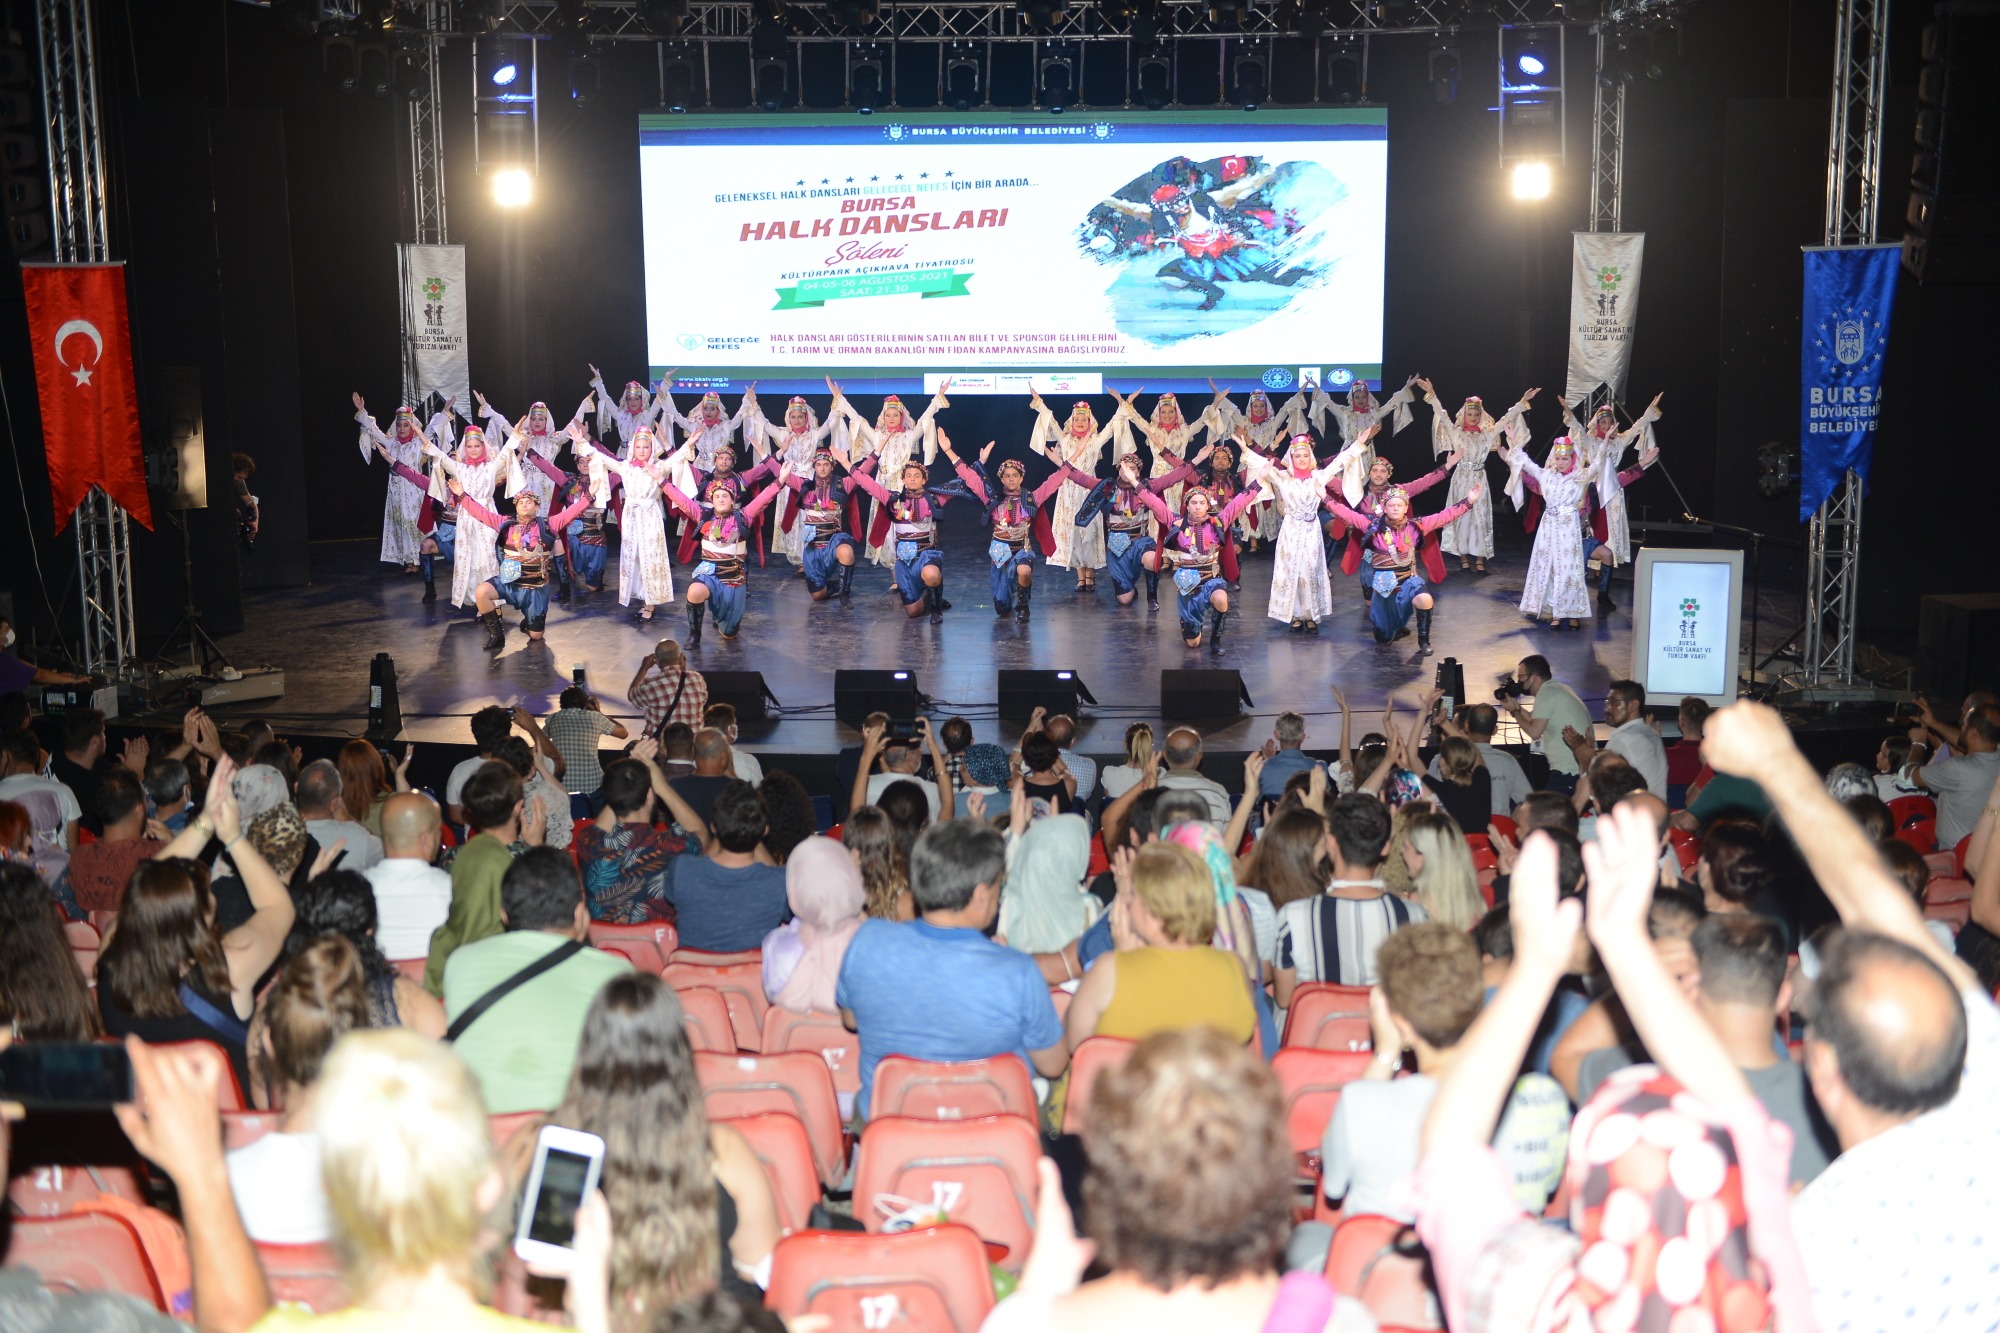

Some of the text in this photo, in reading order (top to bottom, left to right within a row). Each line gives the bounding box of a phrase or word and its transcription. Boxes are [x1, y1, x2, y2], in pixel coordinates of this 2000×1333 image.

[912, 126, 1086, 136] BURSA BÜYÜKŞEHİR BELEDİYESİ
[715, 178, 1039, 203] GELENEKSEL HALK DANSLARI GELECEĞE NEFES İÇİN BİR ARADA...
[840, 196, 916, 214] BURSA
[739, 208, 1009, 242] HALK DANSLARI
[824, 240, 908, 268] Şöleni
[781, 258, 974, 280] KÜLTÜRPARK AÇIKHAVA TİYATROSU
[803, 272, 948, 290] 04-05-06 AĞUSTOS 2021
[840, 284, 908, 296] SAAT: 21.30
[1578, 325, 1602, 333] KÜLTÜR
[1596, 318, 1618, 326] BURSA
[413, 342, 437, 350] URİZM
[770, 333, 1117, 342] HALK DANSLARI GÖSTERİLERİNİN SATILAN BİLET VE SPONSOR GELİRLERİNİ
[771, 346, 788, 354] T.C.
[792, 346, 820, 354] TARIM
[824, 346, 835, 354] VE
[838, 346, 872, 354] ORMAN
[874, 345, 944, 354] BAKANLIĞI'NIN
[948, 346, 976, 354] FİDAN
[978, 346, 1054, 354] KAMPANYASINA
[1810, 385, 1882, 404] BURSA
[932, 1180, 964, 1211] 17
[859, 1294, 898, 1330] 17
